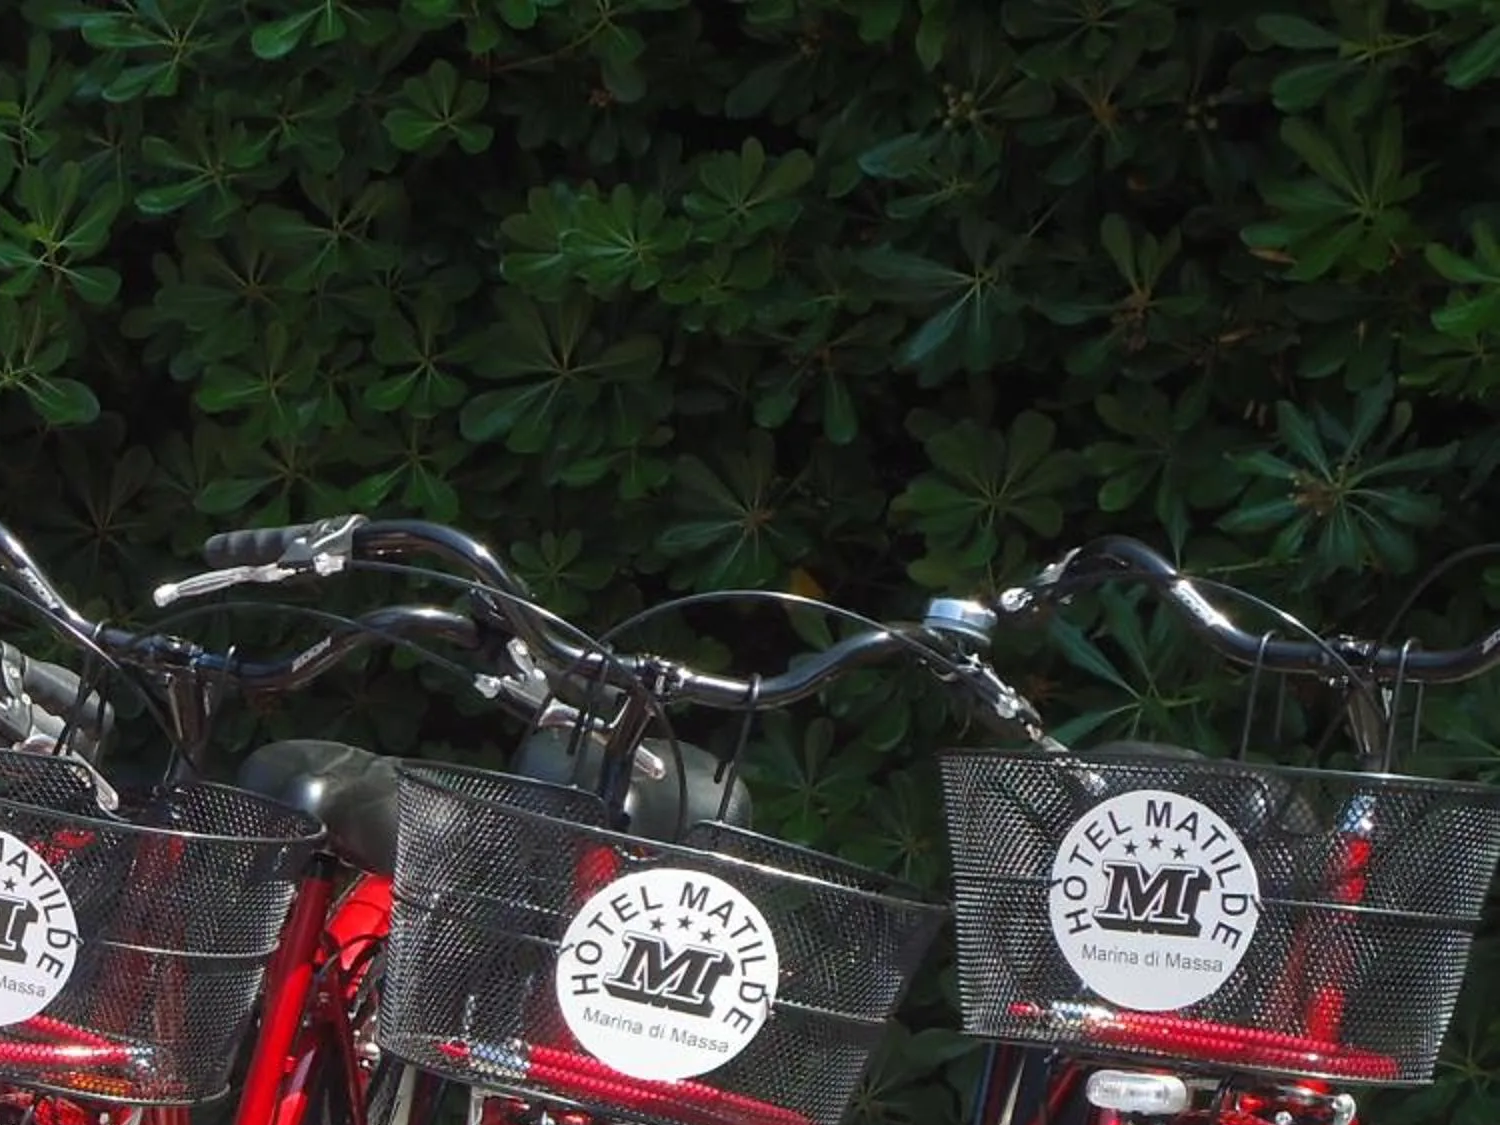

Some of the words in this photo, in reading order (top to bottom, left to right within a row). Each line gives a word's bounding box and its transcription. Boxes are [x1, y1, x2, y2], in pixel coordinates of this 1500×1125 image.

[1063, 810, 1132, 934] HOTEL
[1145, 800, 1248, 949] MATILDE
[571, 886, 663, 996] HOTEL
[679, 882, 767, 1035] MATILDE
[1082, 944, 1139, 965] Marina
[1144, 951, 1159, 967] di
[1166, 952, 1223, 973] Massa
[583, 1007, 643, 1035] Marina
[648, 1023, 665, 1039] di
[671, 1029, 729, 1053] Massa
